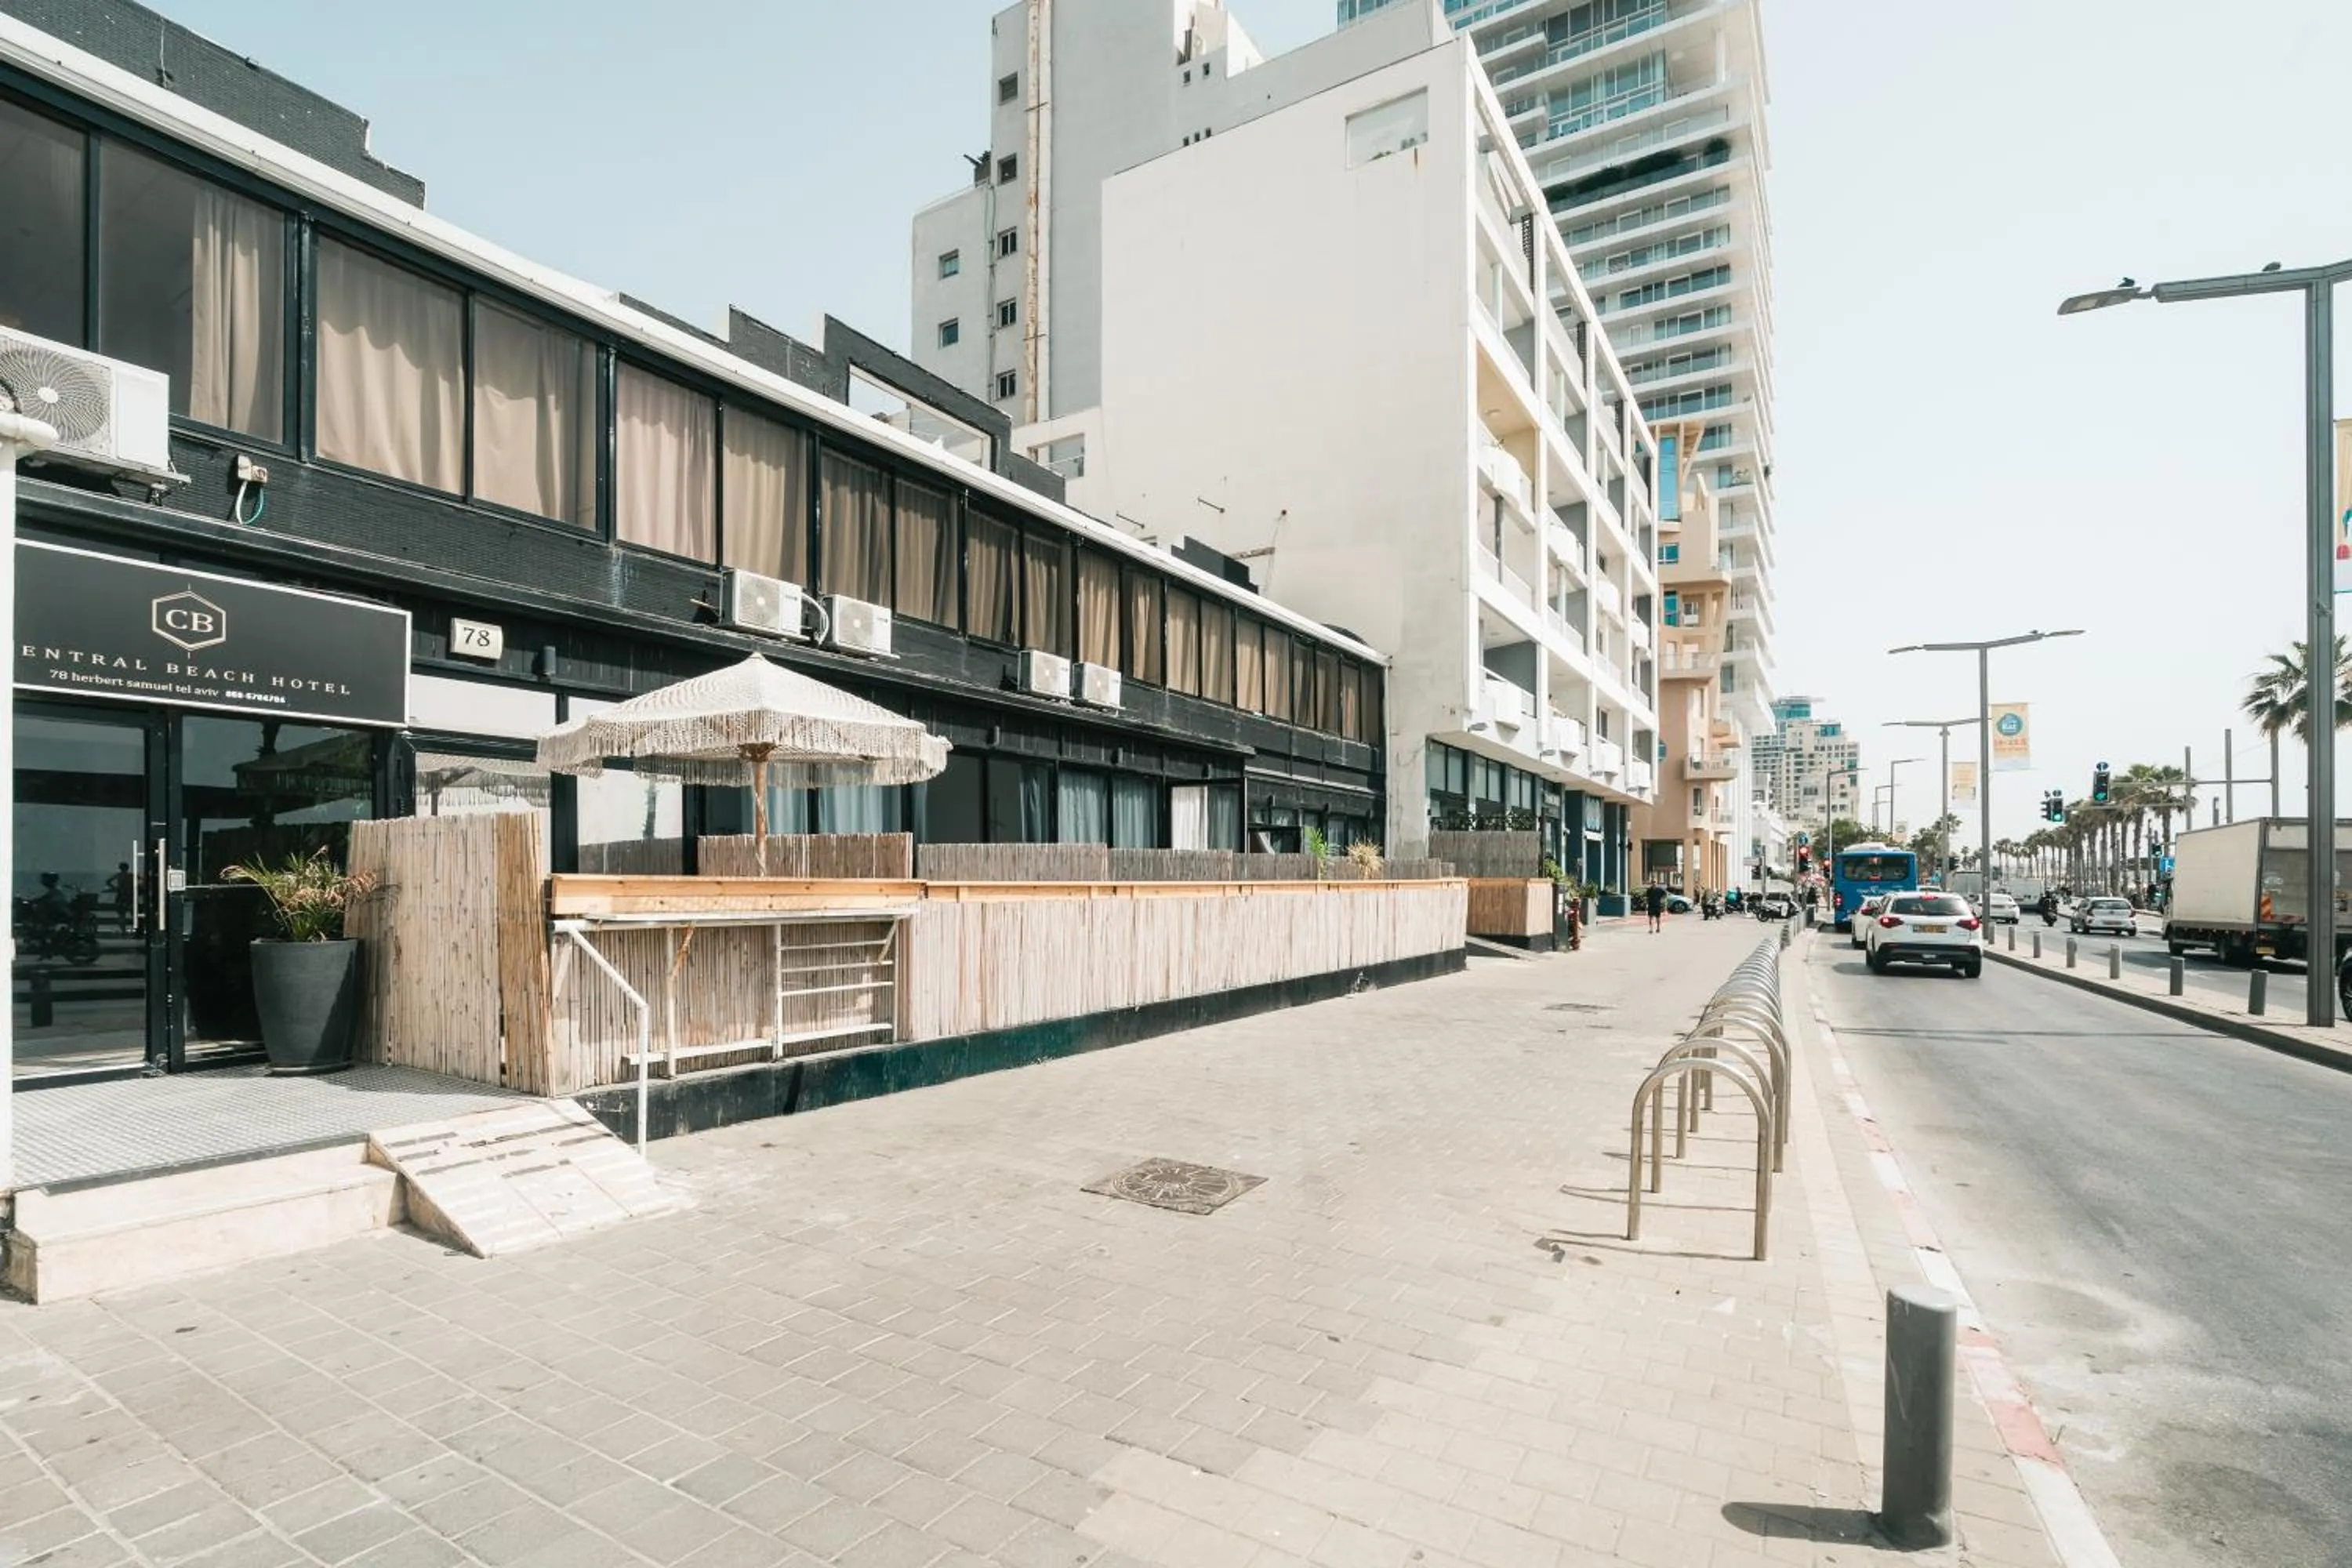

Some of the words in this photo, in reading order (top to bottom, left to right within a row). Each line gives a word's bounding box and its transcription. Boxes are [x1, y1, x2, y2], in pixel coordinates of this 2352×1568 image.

[165, 608, 213, 633] CB
[463, 626, 491, 648] 78
[22, 644, 147, 670] ENTRAL
[166, 662, 254, 684] BEACH
[271, 676, 350, 695] HOTEL
[49, 669, 68, 681] 78
[71, 671, 124, 686] herbert
[126, 680, 172, 692] samuel
[175, 684, 191, 694] tel
[194, 688, 219, 697] aviv
